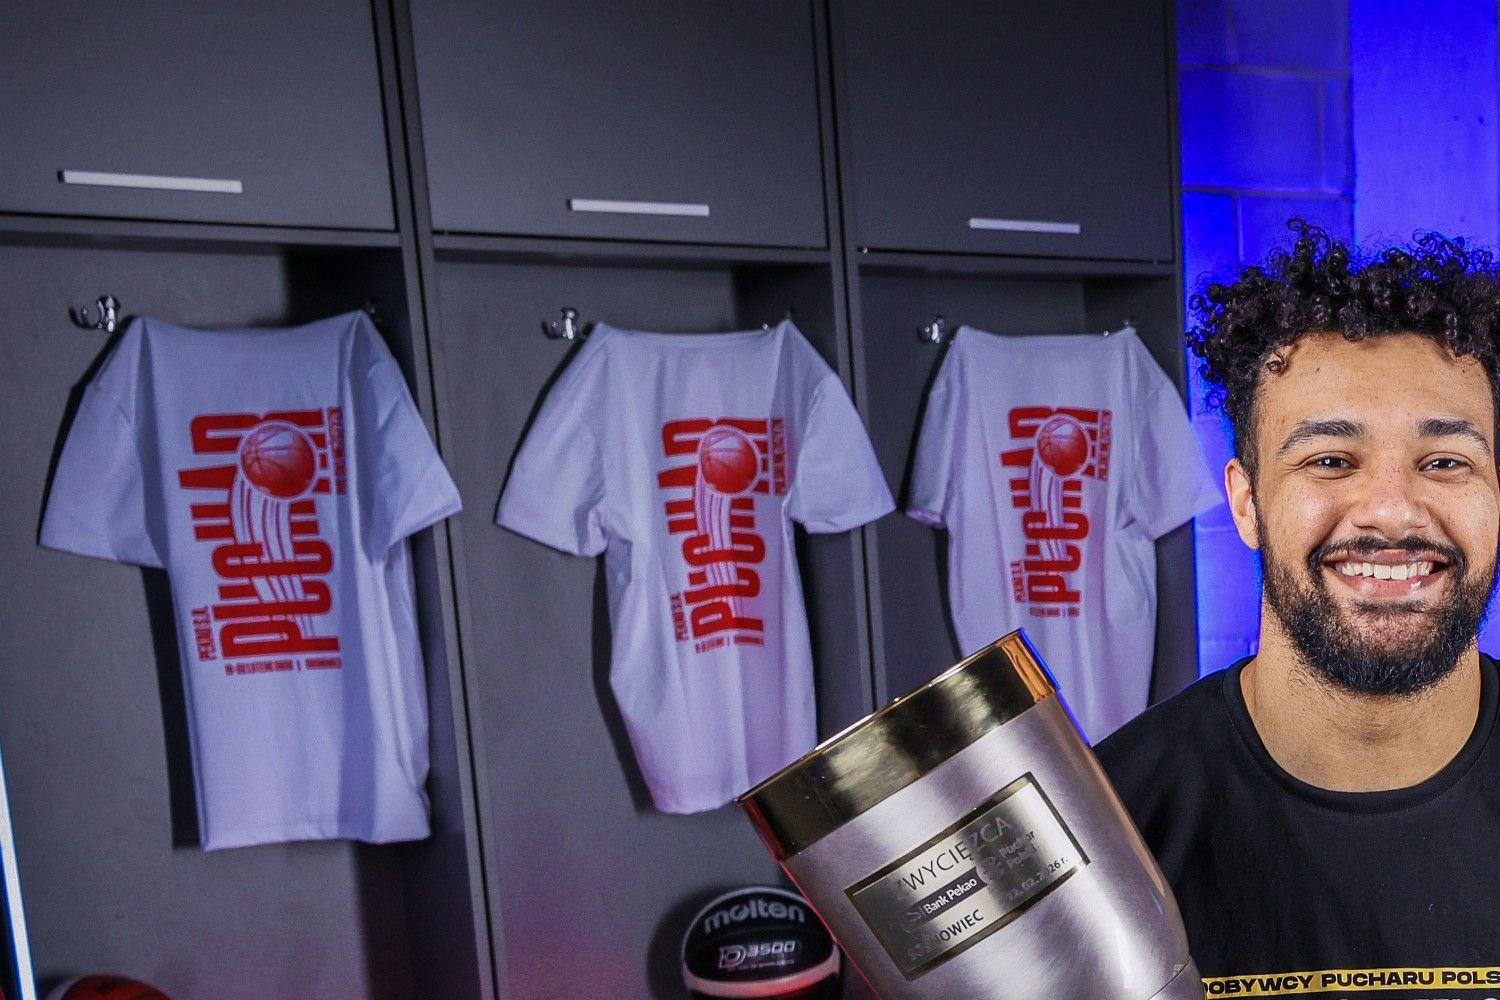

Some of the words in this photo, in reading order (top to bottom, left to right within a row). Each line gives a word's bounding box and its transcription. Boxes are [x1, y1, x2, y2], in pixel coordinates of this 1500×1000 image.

[922, 895, 951, 914] Bank
[946, 878, 977, 900] Pekao
[704, 898, 805, 934] molten
[1202, 975, 1314, 995] OBYWCY
[1321, 971, 1435, 988] PUCHARU
